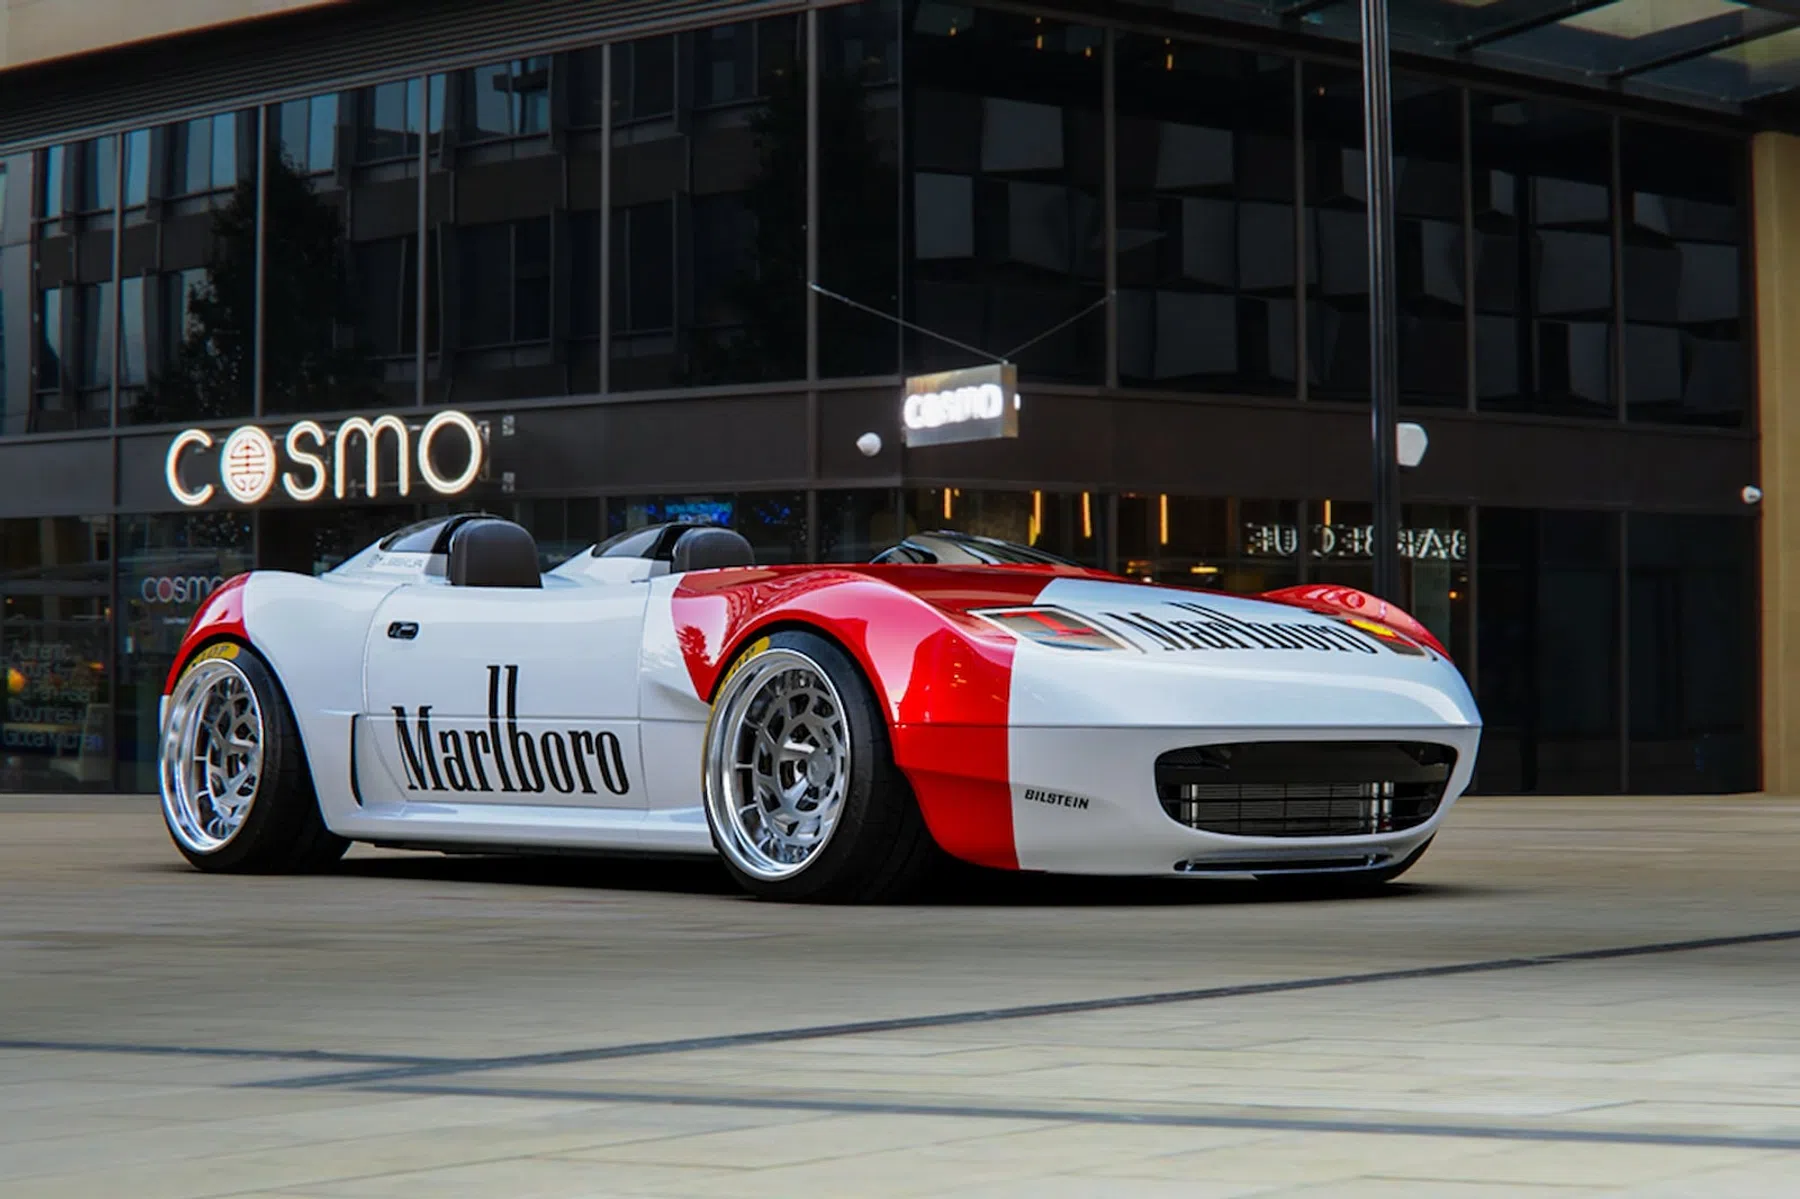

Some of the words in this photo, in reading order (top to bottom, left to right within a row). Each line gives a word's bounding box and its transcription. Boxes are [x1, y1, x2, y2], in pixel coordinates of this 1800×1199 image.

[1098, 601, 1378, 653] Marlboro
[391, 665, 630, 795] Marlboro
[1024, 788, 1089, 810] BILSTEIN
